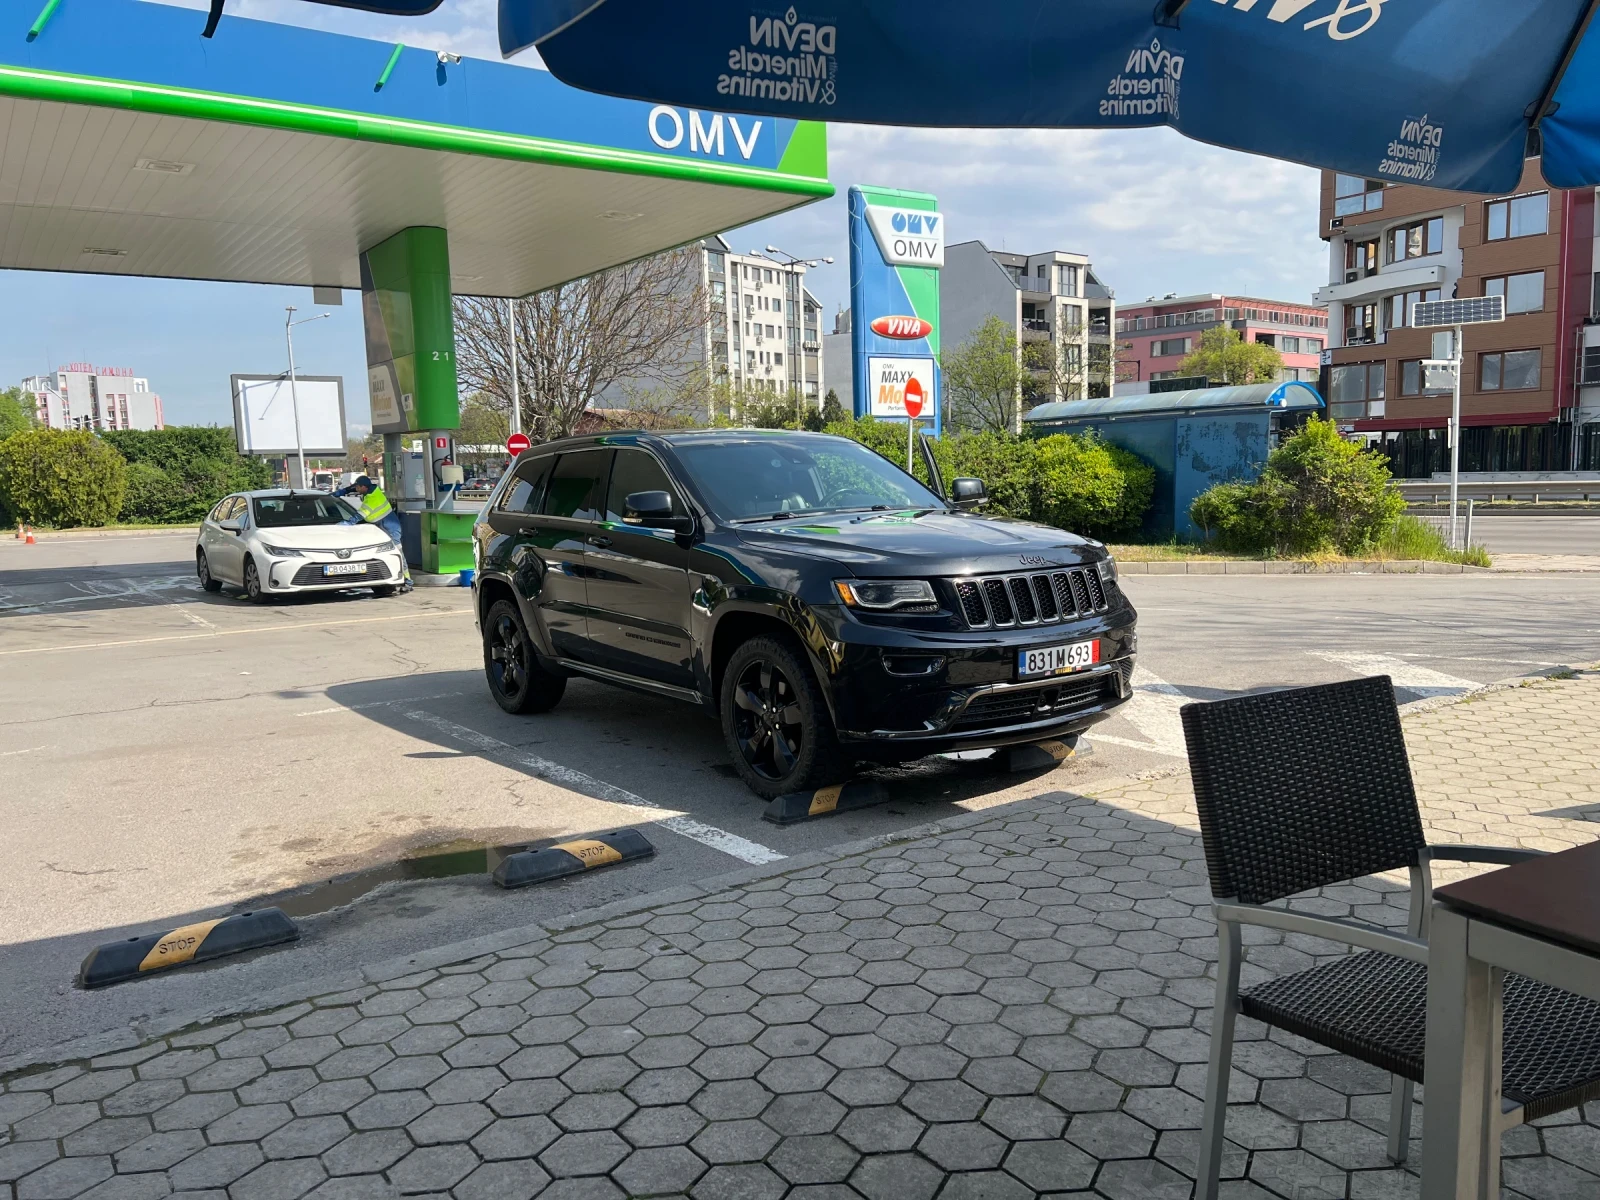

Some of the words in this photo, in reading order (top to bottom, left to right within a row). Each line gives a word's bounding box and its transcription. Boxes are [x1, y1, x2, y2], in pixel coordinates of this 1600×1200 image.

[648, 105, 763, 160] OMV
[894, 239, 938, 259] OMV
[887, 318, 921, 336] VIVA
[69, 363, 93, 372] ХОТЕЛ
[95, 367, 133, 376] СИМОНА
[1019, 554, 1047, 566] Jeep
[815, 793, 836, 805] STOP
[580, 845, 605, 859] STOP
[159, 936, 196, 955] STOP
